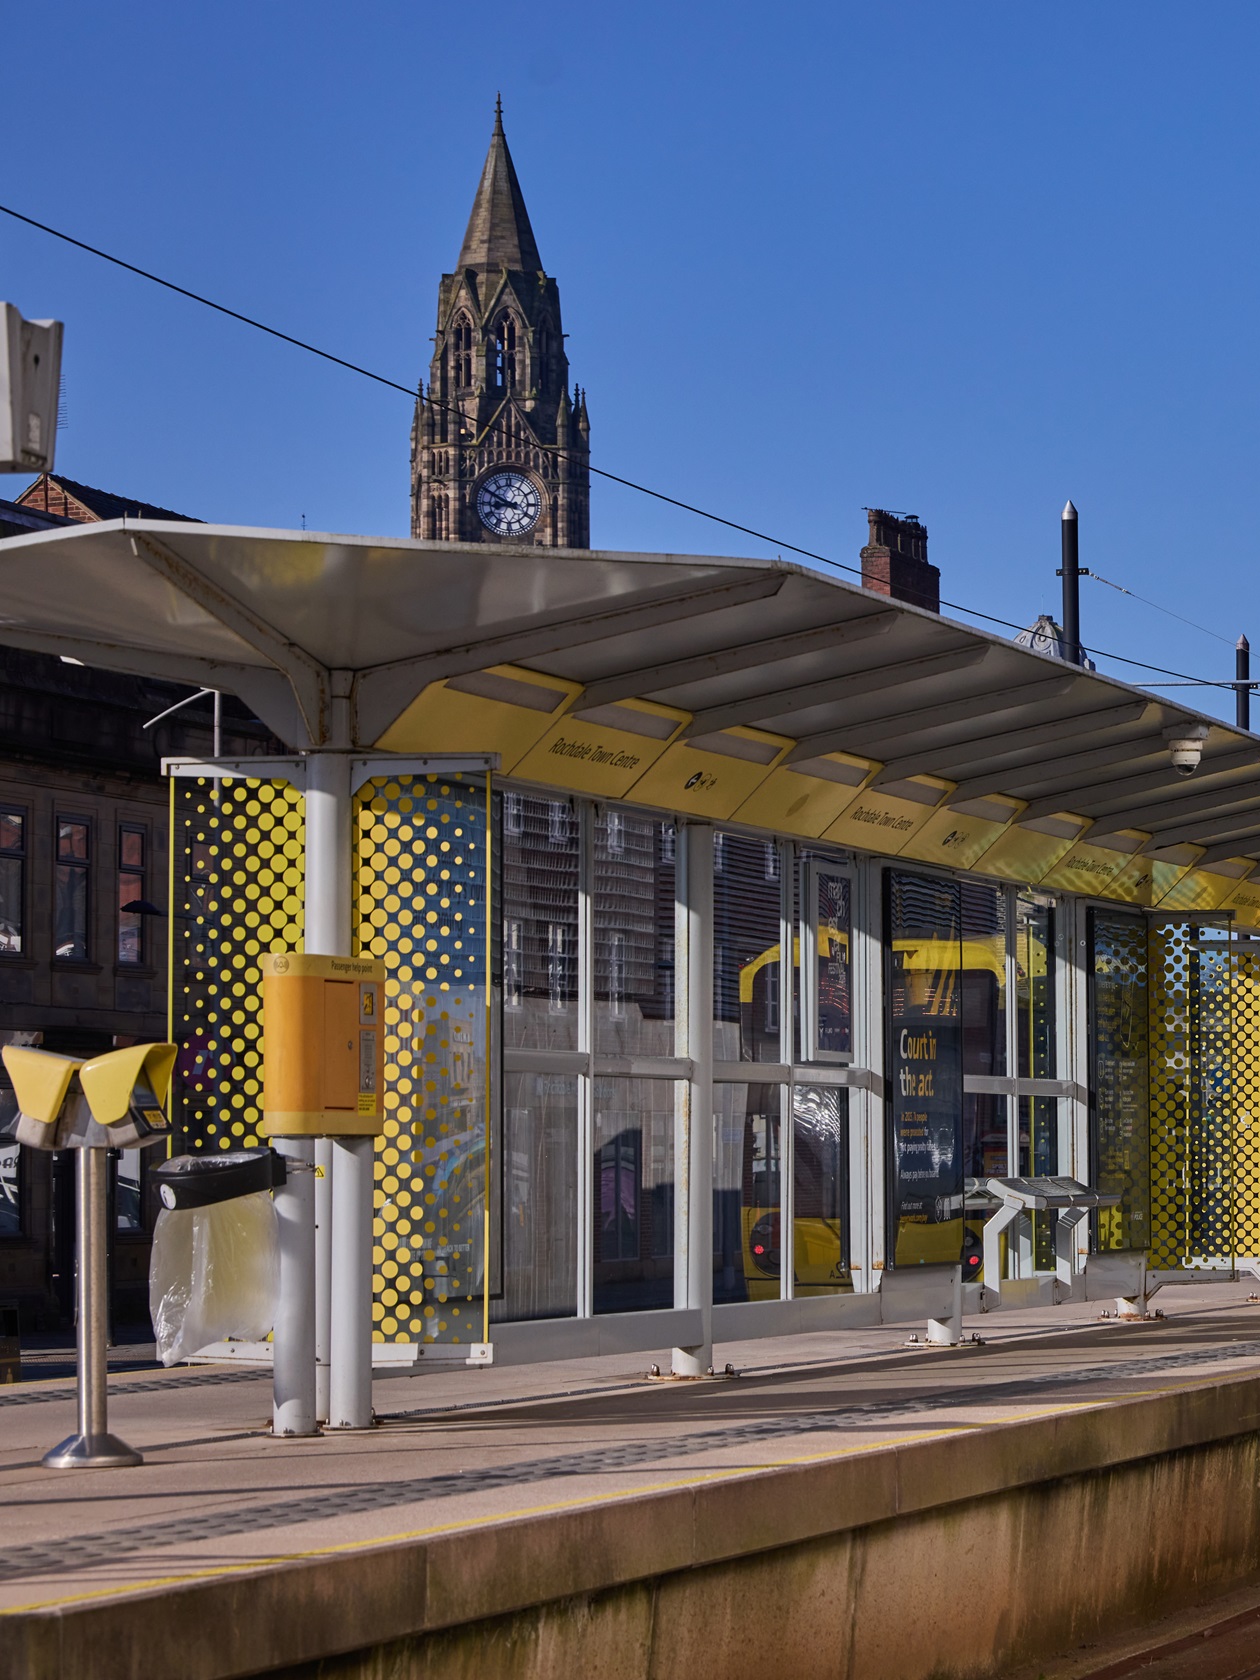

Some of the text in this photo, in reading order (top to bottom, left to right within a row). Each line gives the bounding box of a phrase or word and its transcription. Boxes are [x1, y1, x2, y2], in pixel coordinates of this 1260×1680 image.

[548, 737, 640, 769] Rochdale Town Centre
[850, 806, 914, 831] Rochdale Town Centre
[331, 960, 372, 975] Passenger help point
[900, 1028, 937, 1060] Court in
[899, 1066, 934, 1097] the act.
